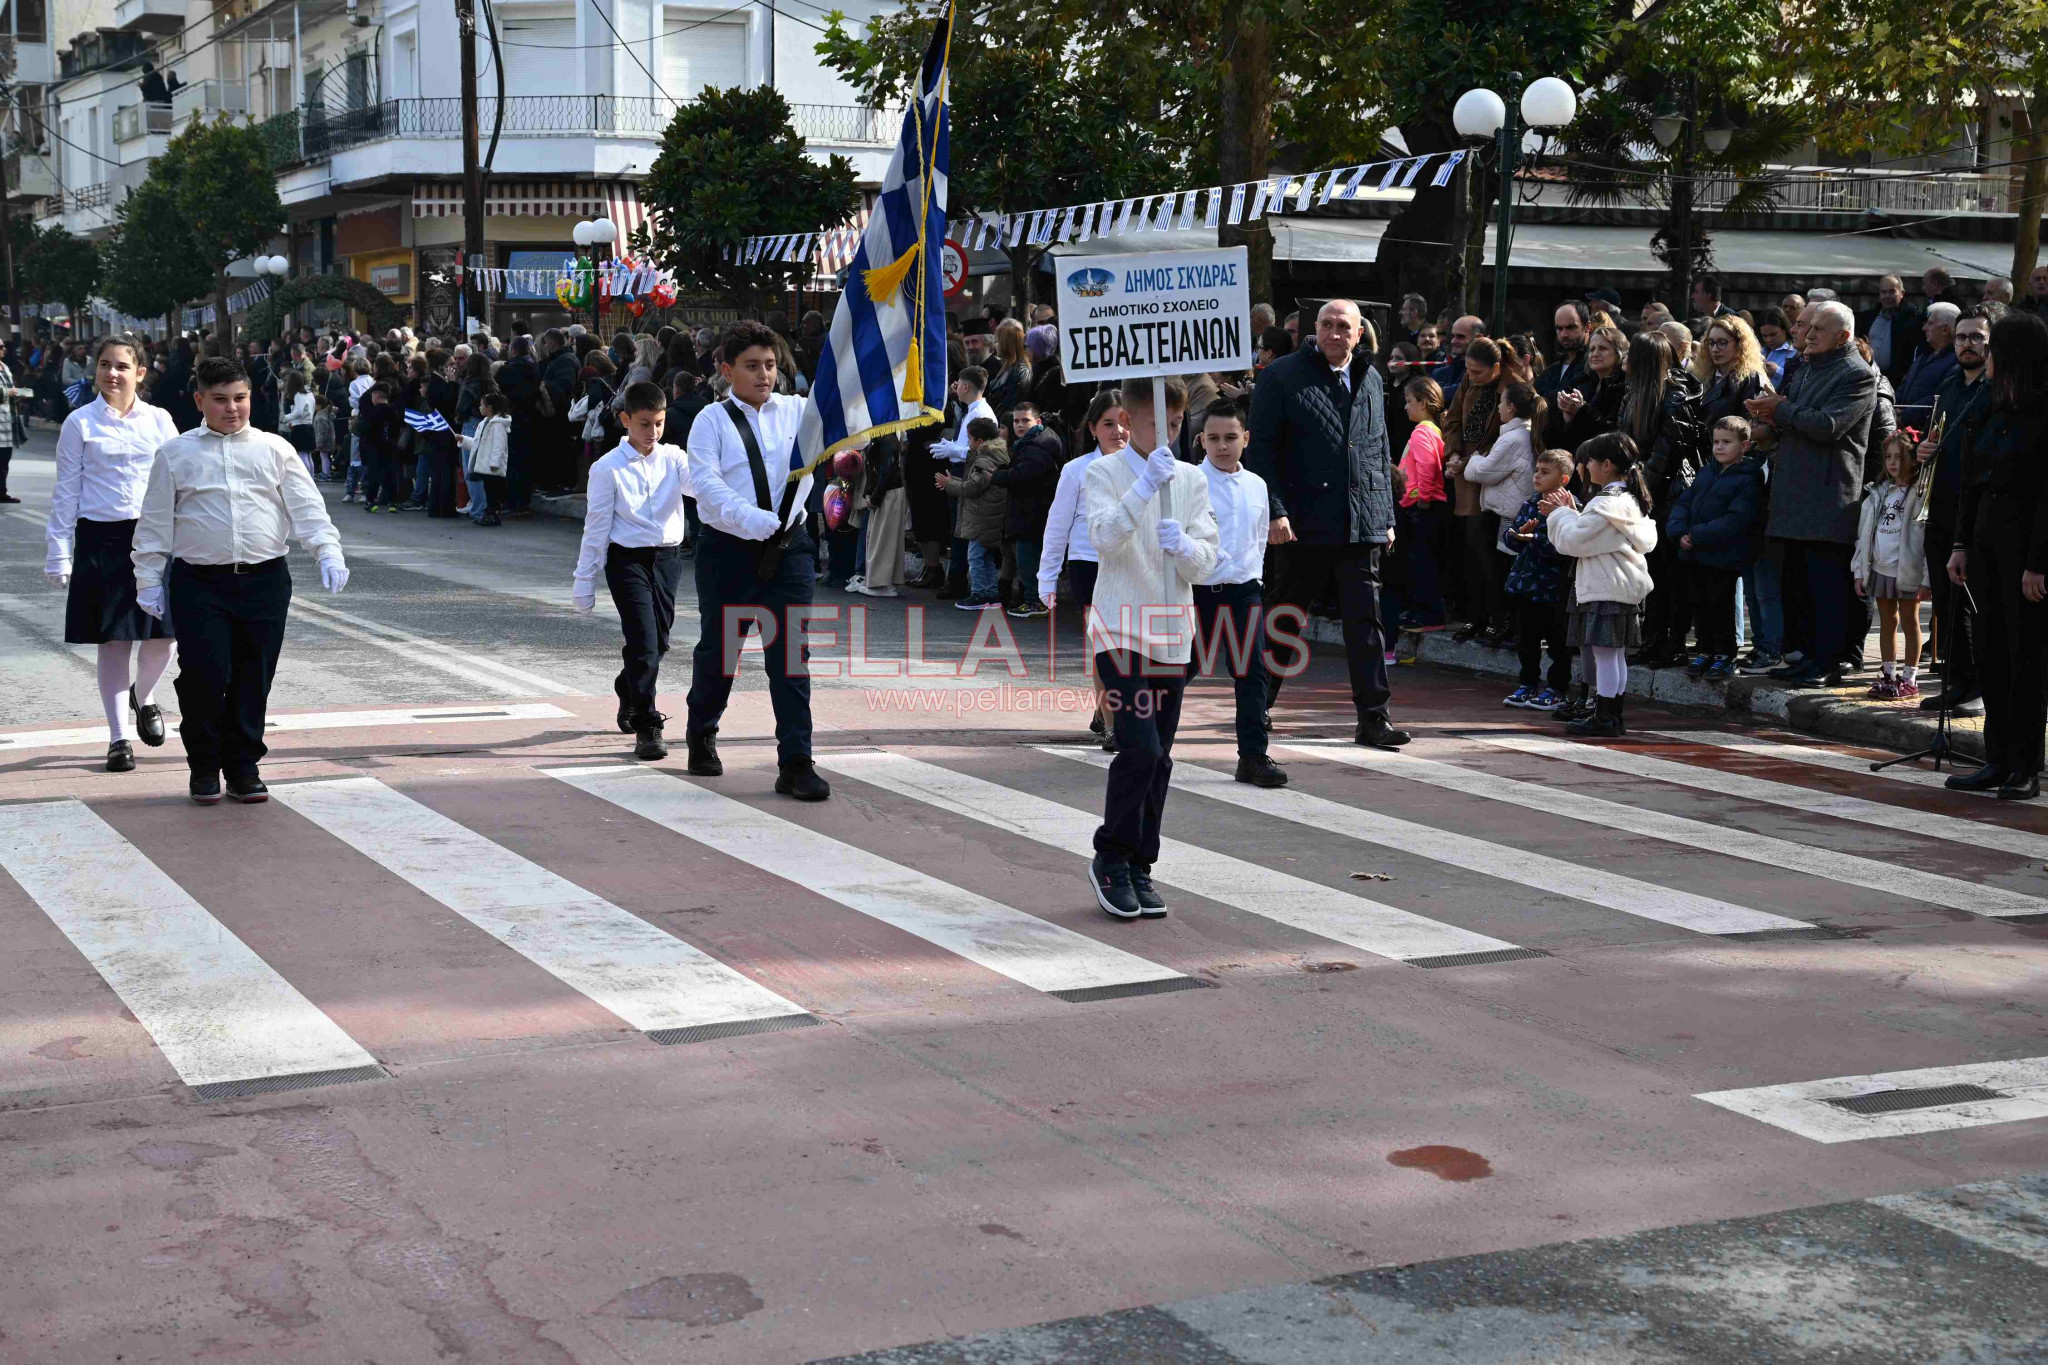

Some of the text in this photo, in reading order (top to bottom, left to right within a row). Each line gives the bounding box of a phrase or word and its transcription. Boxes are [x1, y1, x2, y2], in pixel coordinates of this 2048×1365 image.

[1125, 264, 1238, 293] ΔΗΜΟΣ ΣΚΥΔΡΑΣ
[1089, 299, 1219, 318] ΔΗΜΟΤΙΚΟ ΣΧΟΛΕΙΟ
[1069, 316, 1241, 370] ΣΕΒΑΣΤΕΙΑΝΩΝ
